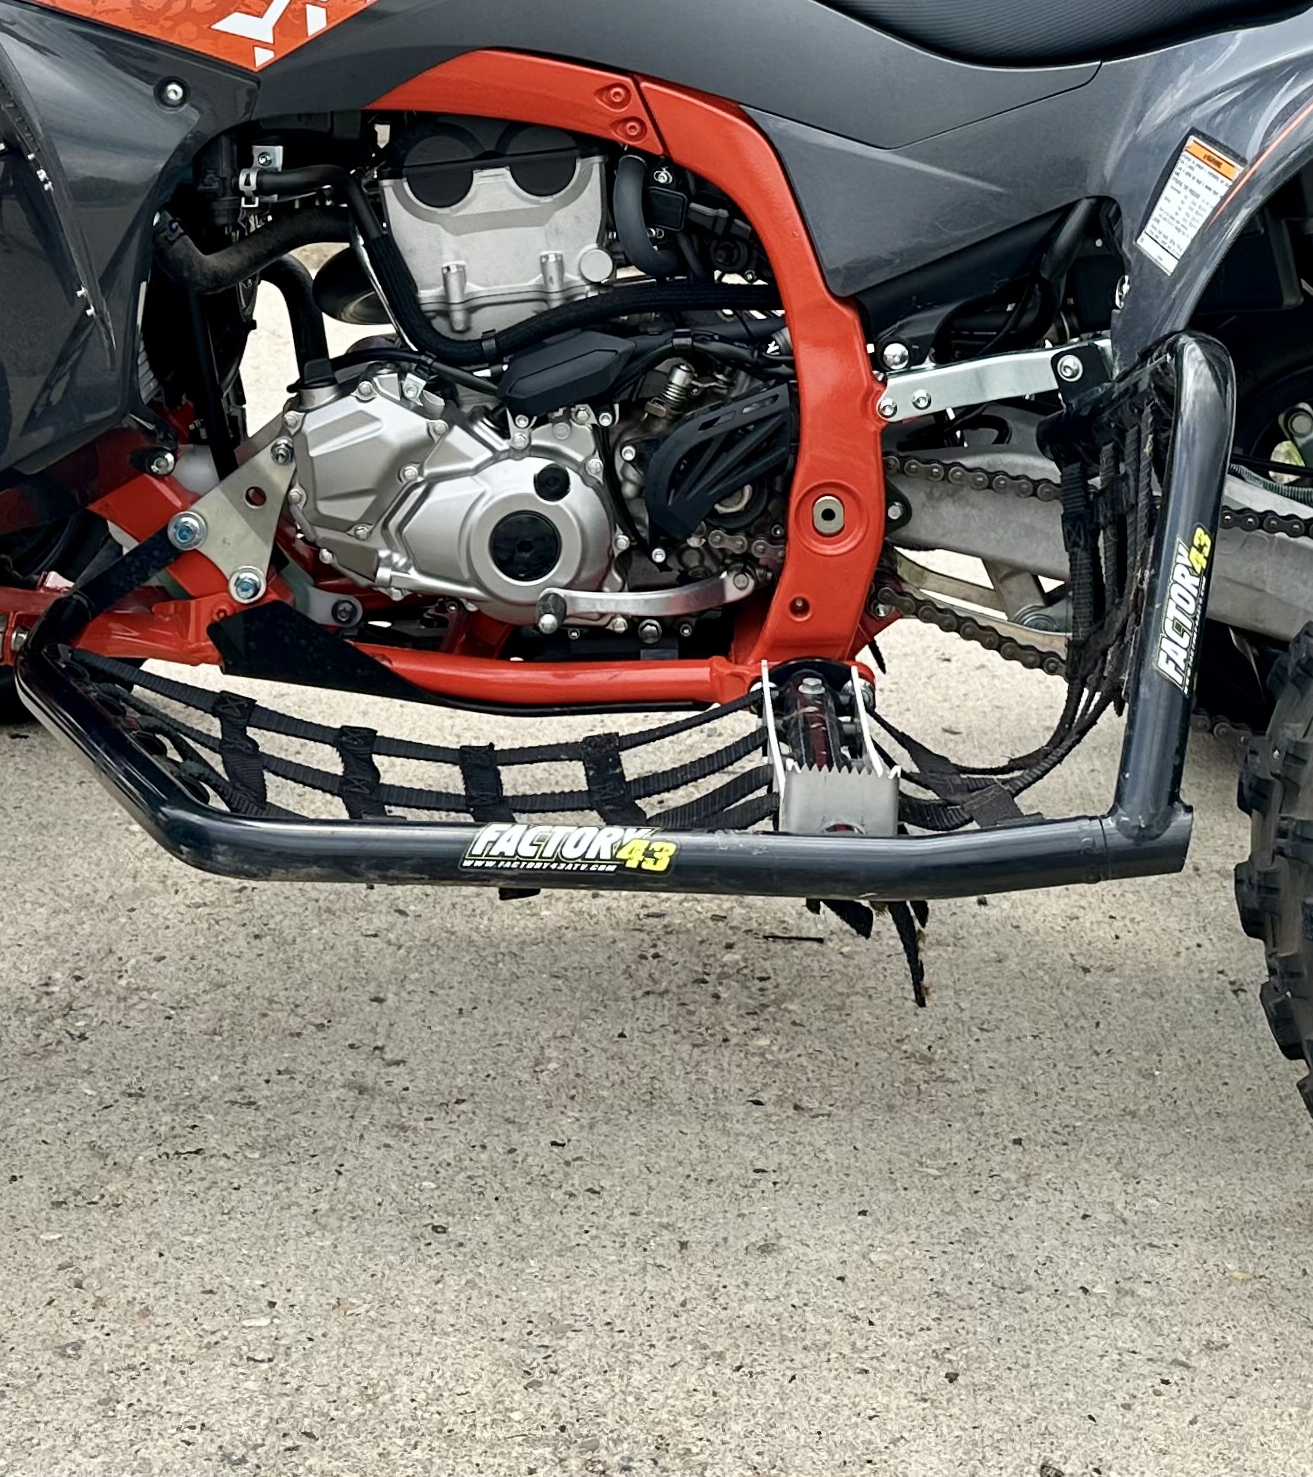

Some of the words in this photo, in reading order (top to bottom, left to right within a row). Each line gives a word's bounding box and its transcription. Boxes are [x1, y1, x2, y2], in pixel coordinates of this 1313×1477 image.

[1157, 541, 1201, 690] FACTORY
[1189, 526, 1212, 574] 43
[468, 823, 653, 860] FACTORY
[616, 839, 676, 872] 43
